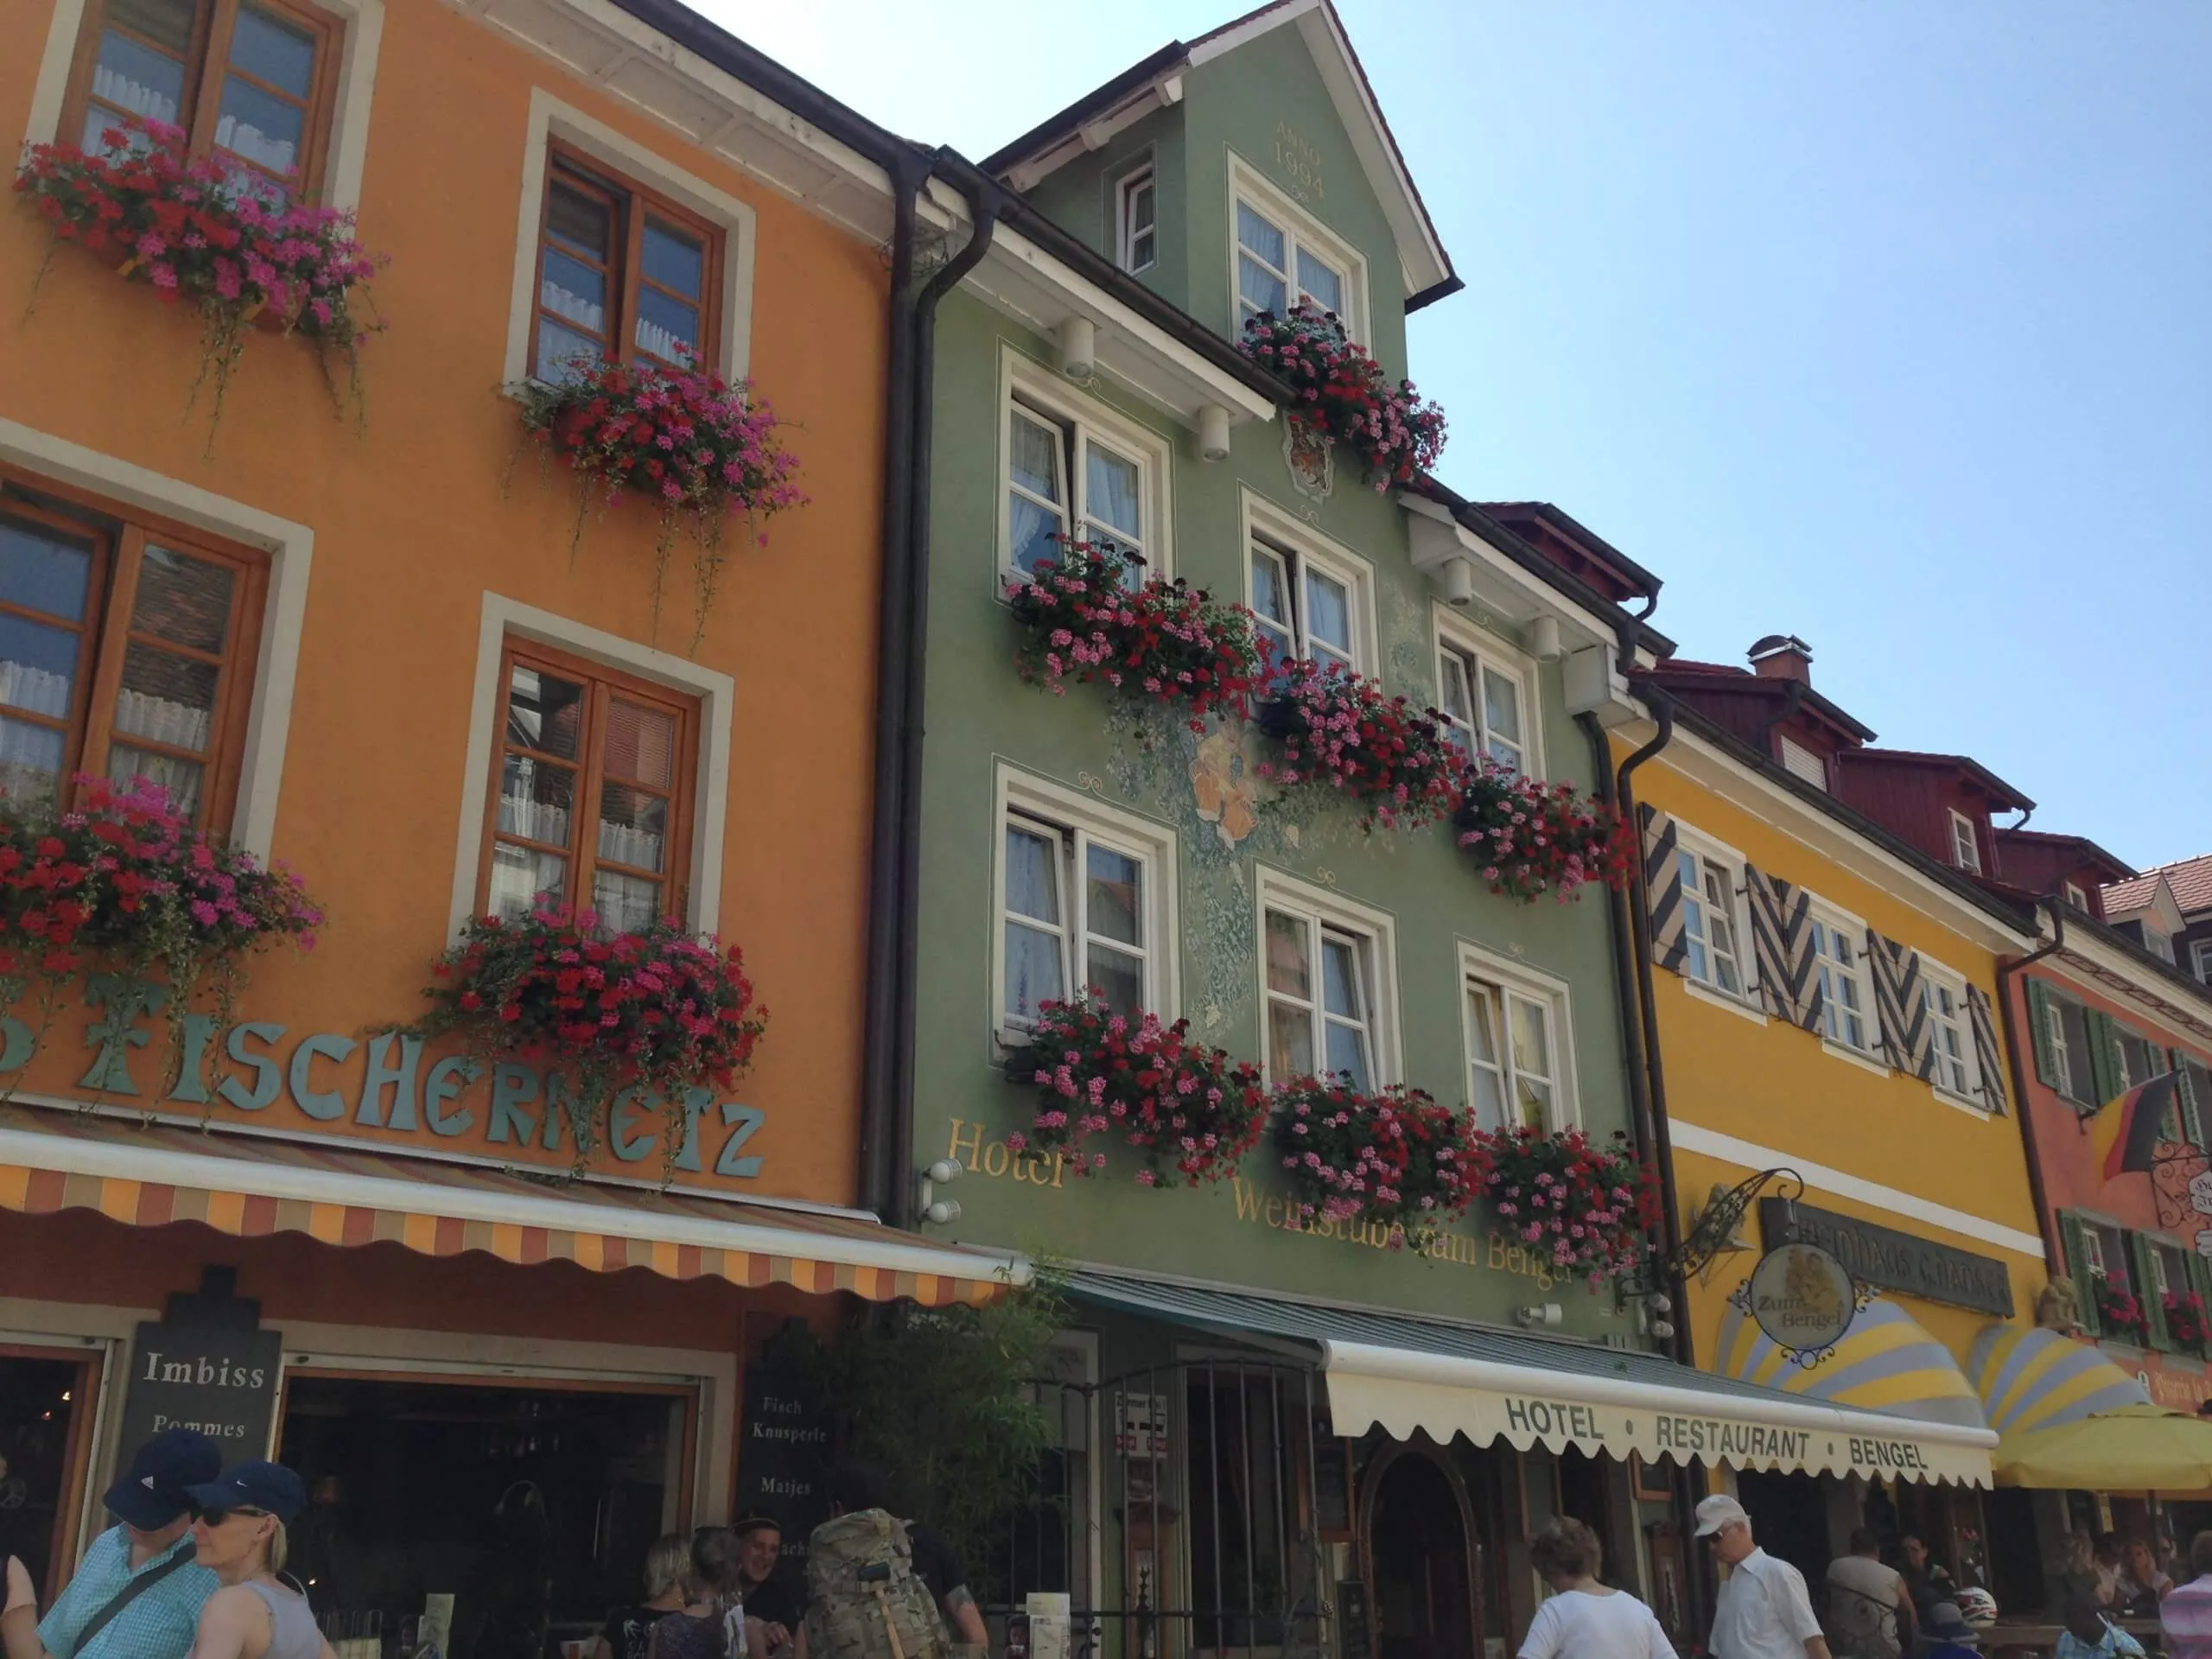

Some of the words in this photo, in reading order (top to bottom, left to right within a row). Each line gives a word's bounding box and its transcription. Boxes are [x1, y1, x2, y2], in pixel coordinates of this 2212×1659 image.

[1275, 141, 1325, 200] 1994
[947, 1117, 1065, 1189] Hotel
[1758, 1294, 1804, 1312] Zum
[1781, 1309, 1842, 1331] Bengel
[142, 1351, 265, 1389] Imbiss
[763, 1396, 802, 1415] Fisch
[1505, 1397, 1605, 1440] HOTEL
[1656, 1414, 1811, 1459] RESTAURANT
[1849, 1437, 1929, 1470] BENGEL
[760, 1477, 812, 1498] Matjes
